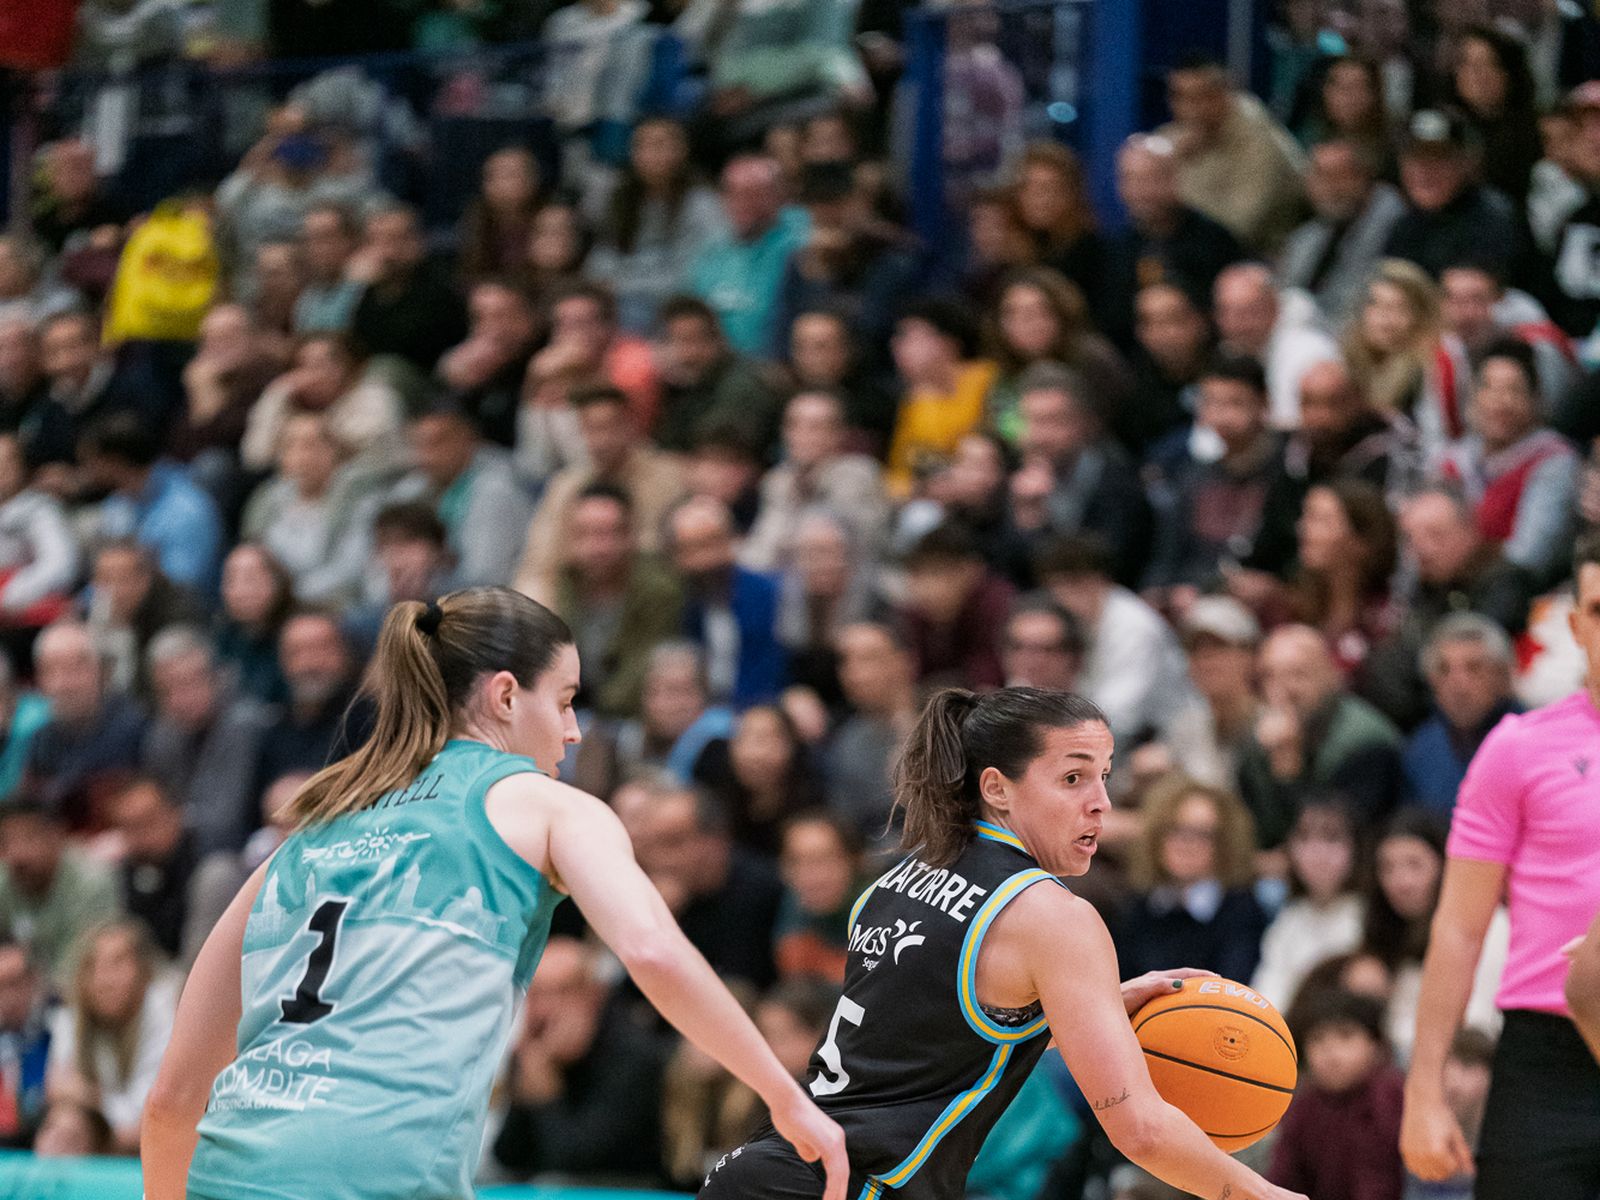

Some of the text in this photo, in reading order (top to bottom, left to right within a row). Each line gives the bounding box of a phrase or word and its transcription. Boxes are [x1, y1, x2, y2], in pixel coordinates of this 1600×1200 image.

[278, 896, 352, 1026] 1
[848, 923, 892, 956] MGS
[808, 995, 866, 1098] 5
